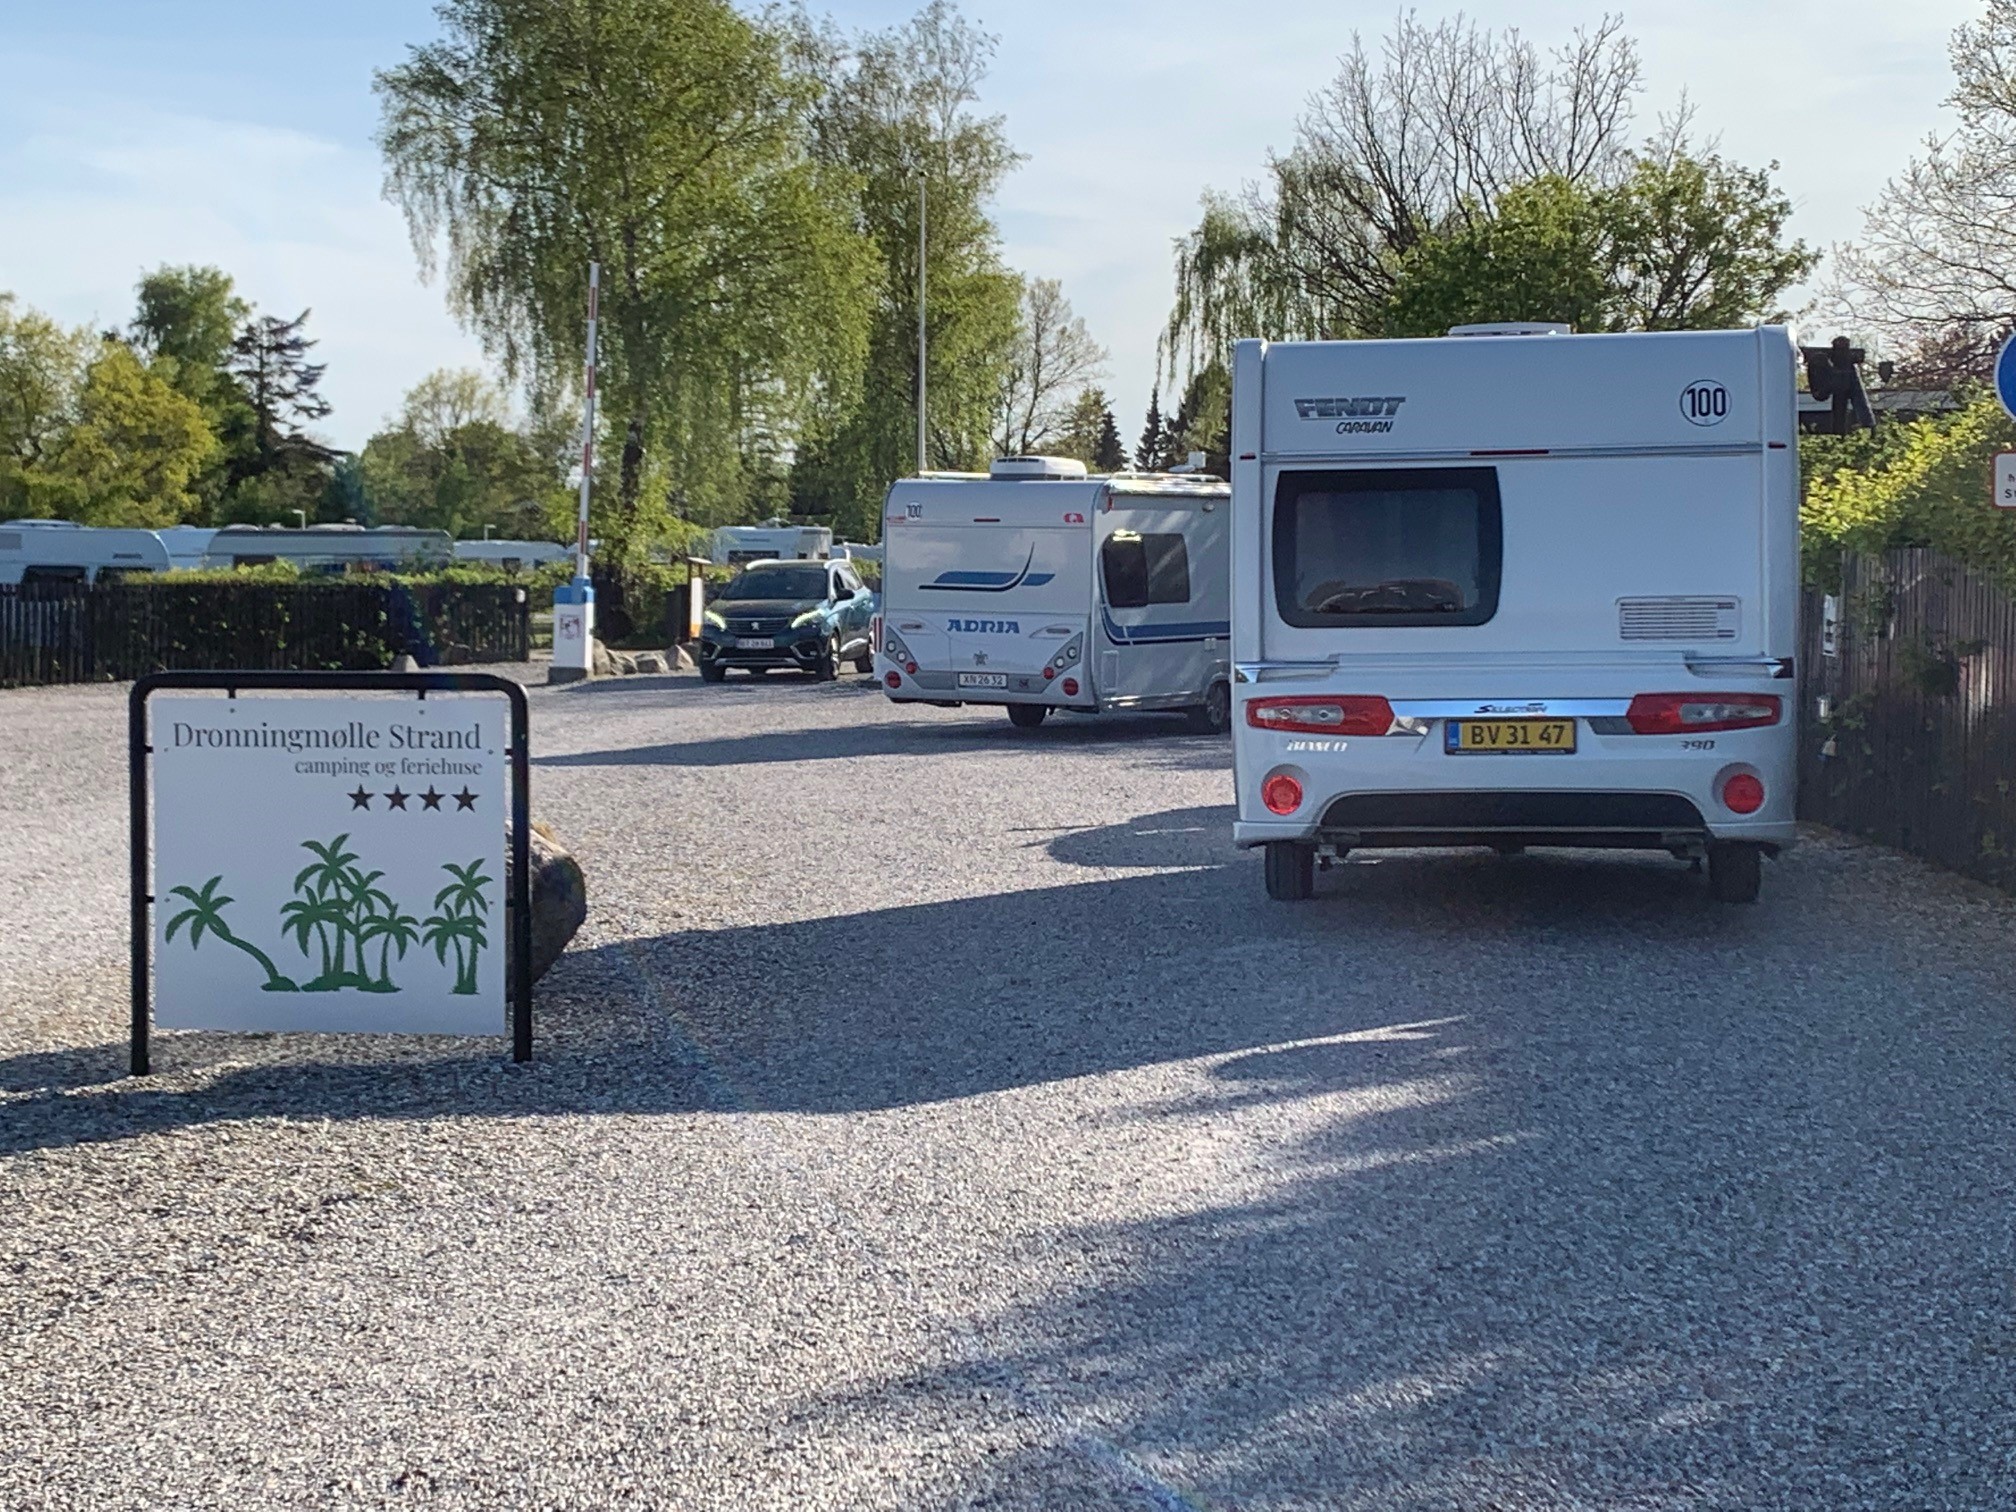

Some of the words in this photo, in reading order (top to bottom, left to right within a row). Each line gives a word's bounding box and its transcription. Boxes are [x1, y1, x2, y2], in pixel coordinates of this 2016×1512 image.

[1294, 397, 1406, 418] FENDT
[1687, 387, 1726, 418] 100
[1336, 421, 1393, 435] CARAVAN
[947, 619, 1020, 634] ADRIA
[173, 722, 381, 754] Dronningmølle
[389, 723, 482, 750] Strand
[1471, 725, 1500, 745] BV
[1506, 725, 1531, 745] 31
[1539, 725, 1565, 744] 47
[295, 757, 371, 777] camping
[374, 761, 396, 777] og
[401, 757, 483, 775] feriehuse
